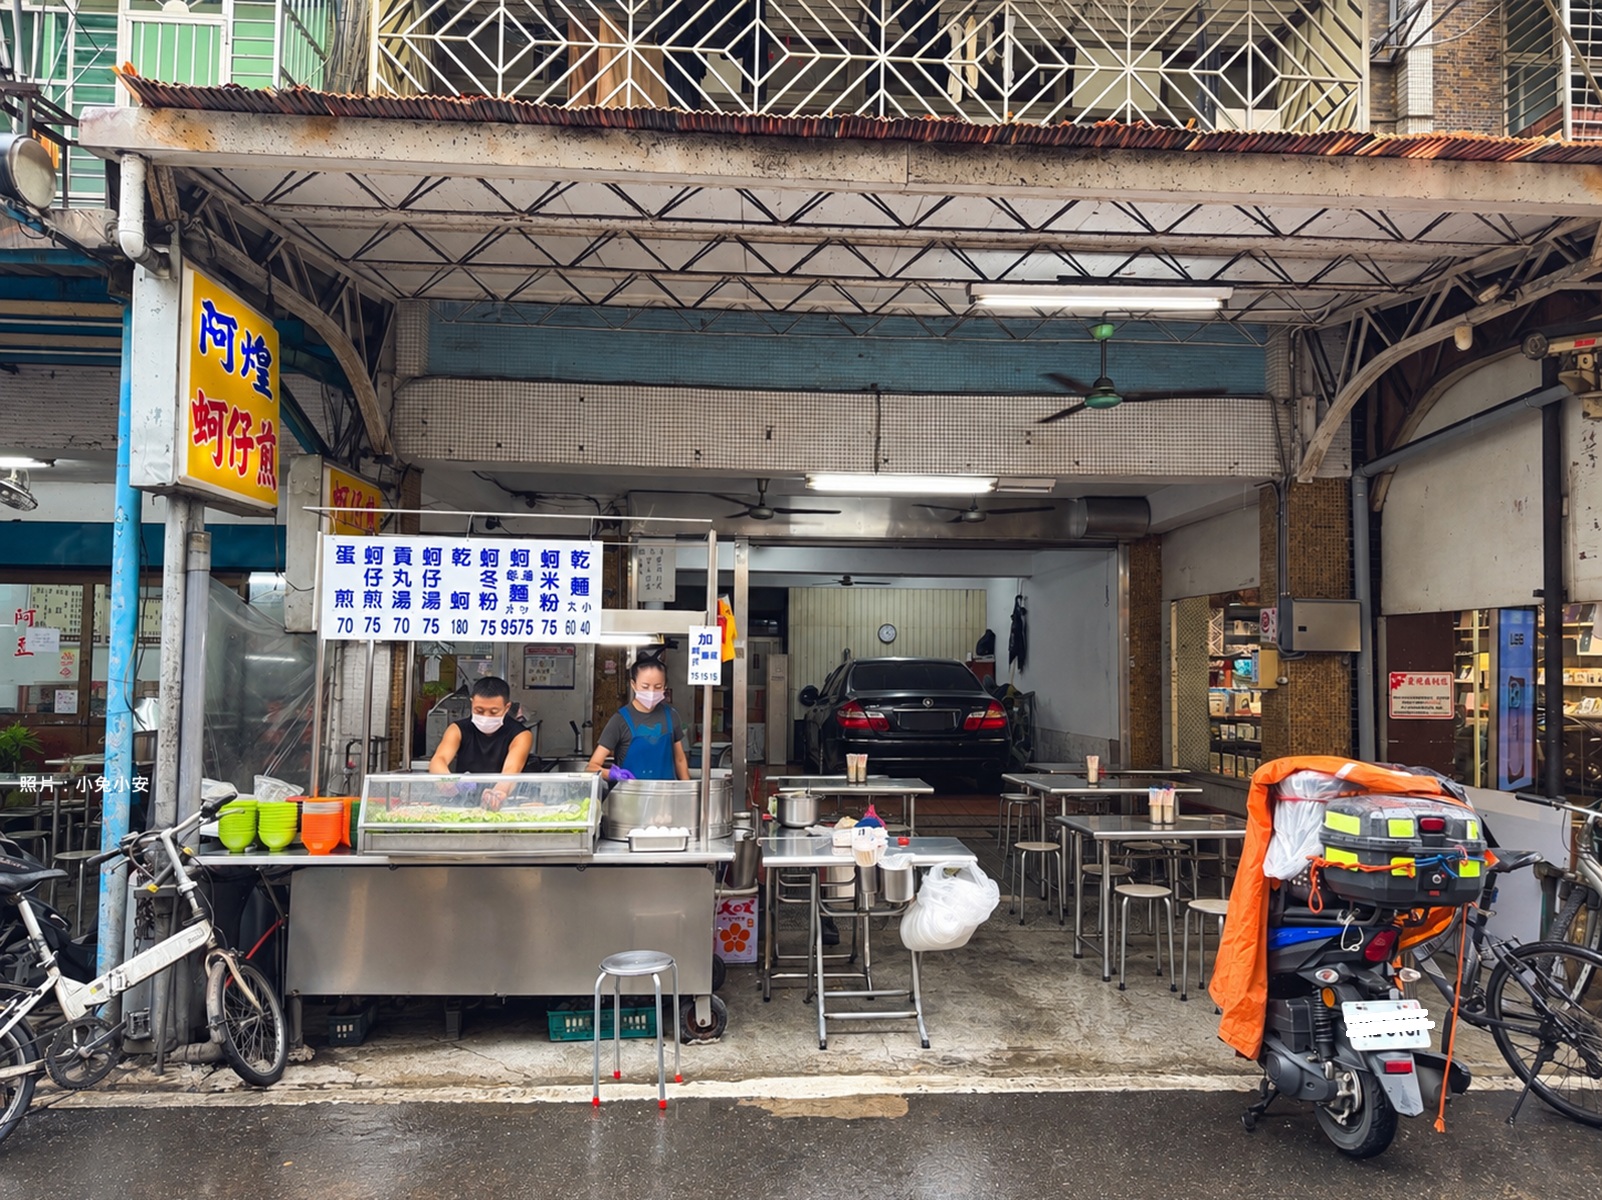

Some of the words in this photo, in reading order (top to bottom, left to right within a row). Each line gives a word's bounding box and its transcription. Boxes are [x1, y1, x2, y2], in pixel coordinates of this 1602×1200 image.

[200, 300, 272, 400] 阿煌
[192, 389, 276, 491] 蚵仔煎
[335, 545, 355, 608] 蛋煎
[363, 546, 384, 609] 蚵仔煎
[392, 546, 413, 609] 貢丸湯
[421, 547, 442, 610] 蚵仔湯
[450, 547, 471, 610] 乾蚵
[479, 548, 500, 611] 蚵冬粉
[539, 549, 560, 612] 蚵米粉
[570, 550, 590, 596] 乾麵
[337, 617, 353, 633] 70
[364, 616, 381, 633] 75
[393, 617, 409, 633] 70
[422, 618, 439, 634] 75
[451, 619, 468, 634] 180
[480, 620, 496, 635] 75
[541, 619, 557, 635] 75
[565, 620, 576, 635] 60
[580, 620, 590, 635] 40
[567, 601, 577, 612] 大
[582, 602, 592, 613] 小
[698, 633, 713, 645] 加
